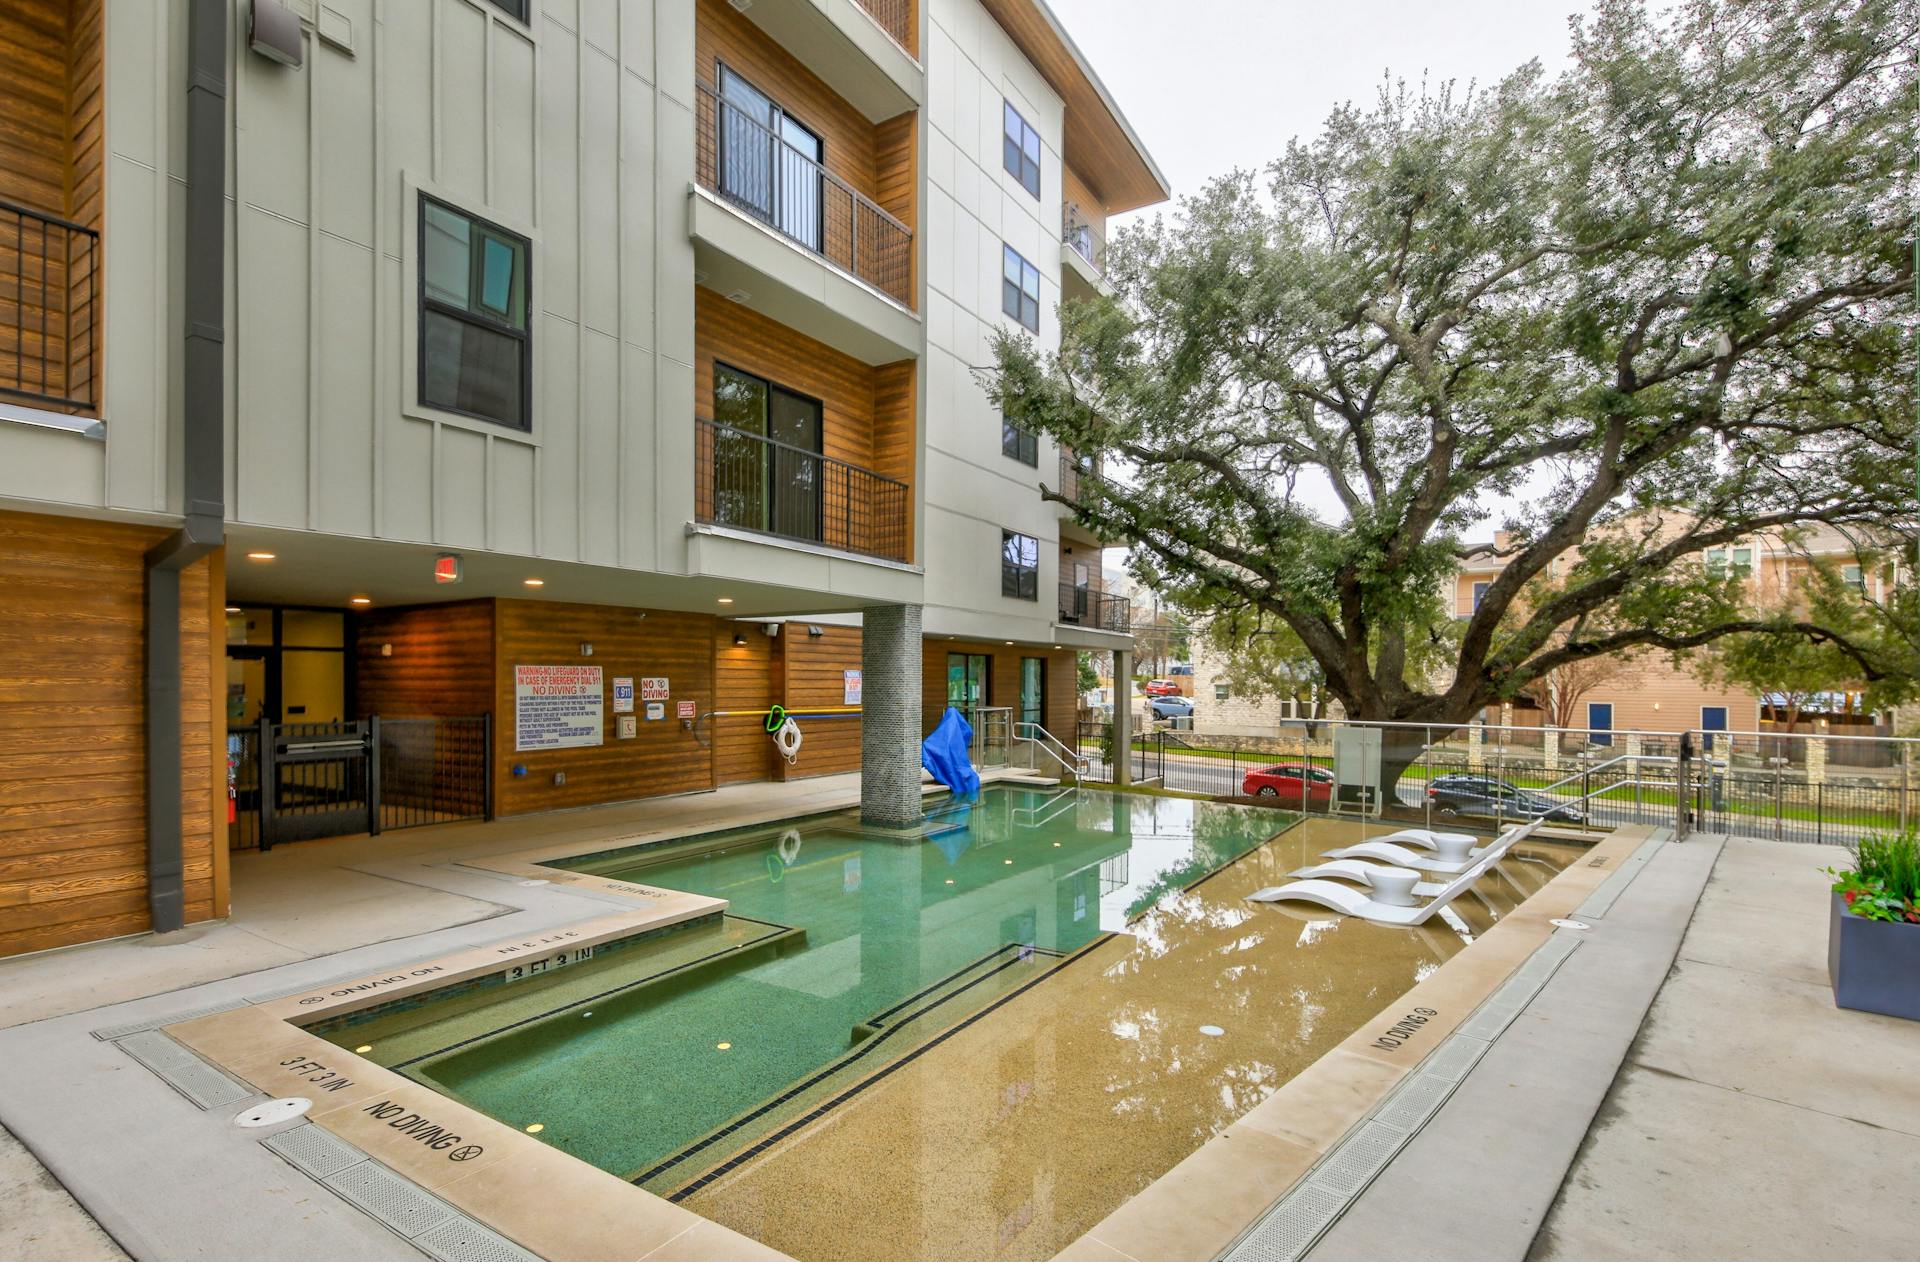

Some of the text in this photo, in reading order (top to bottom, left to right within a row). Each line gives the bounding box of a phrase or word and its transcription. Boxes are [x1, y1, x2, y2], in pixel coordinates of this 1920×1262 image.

[553, 667, 579, 676] LIFEGUARD
[588, 668, 601, 676] DUTY
[526, 676, 539, 686] CASE
[540, 676, 548, 686] OF
[550, 676, 580, 686] EMERGENCY
[581, 676, 592, 686] DIAL
[643, 680, 654, 688] NO
[533, 686, 577, 695] NO DIVING
[621, 687, 631, 697] 911
[643, 689, 668, 699] DIVING
[512, 948, 590, 979] 3 FT 3 IN
[331, 966, 443, 997] NO DIVING
[1370, 1014, 1428, 1052] NO DIVING
[280, 1056, 354, 1092] 3 FT 3 IN
[362, 1100, 461, 1150] NO DIVING
